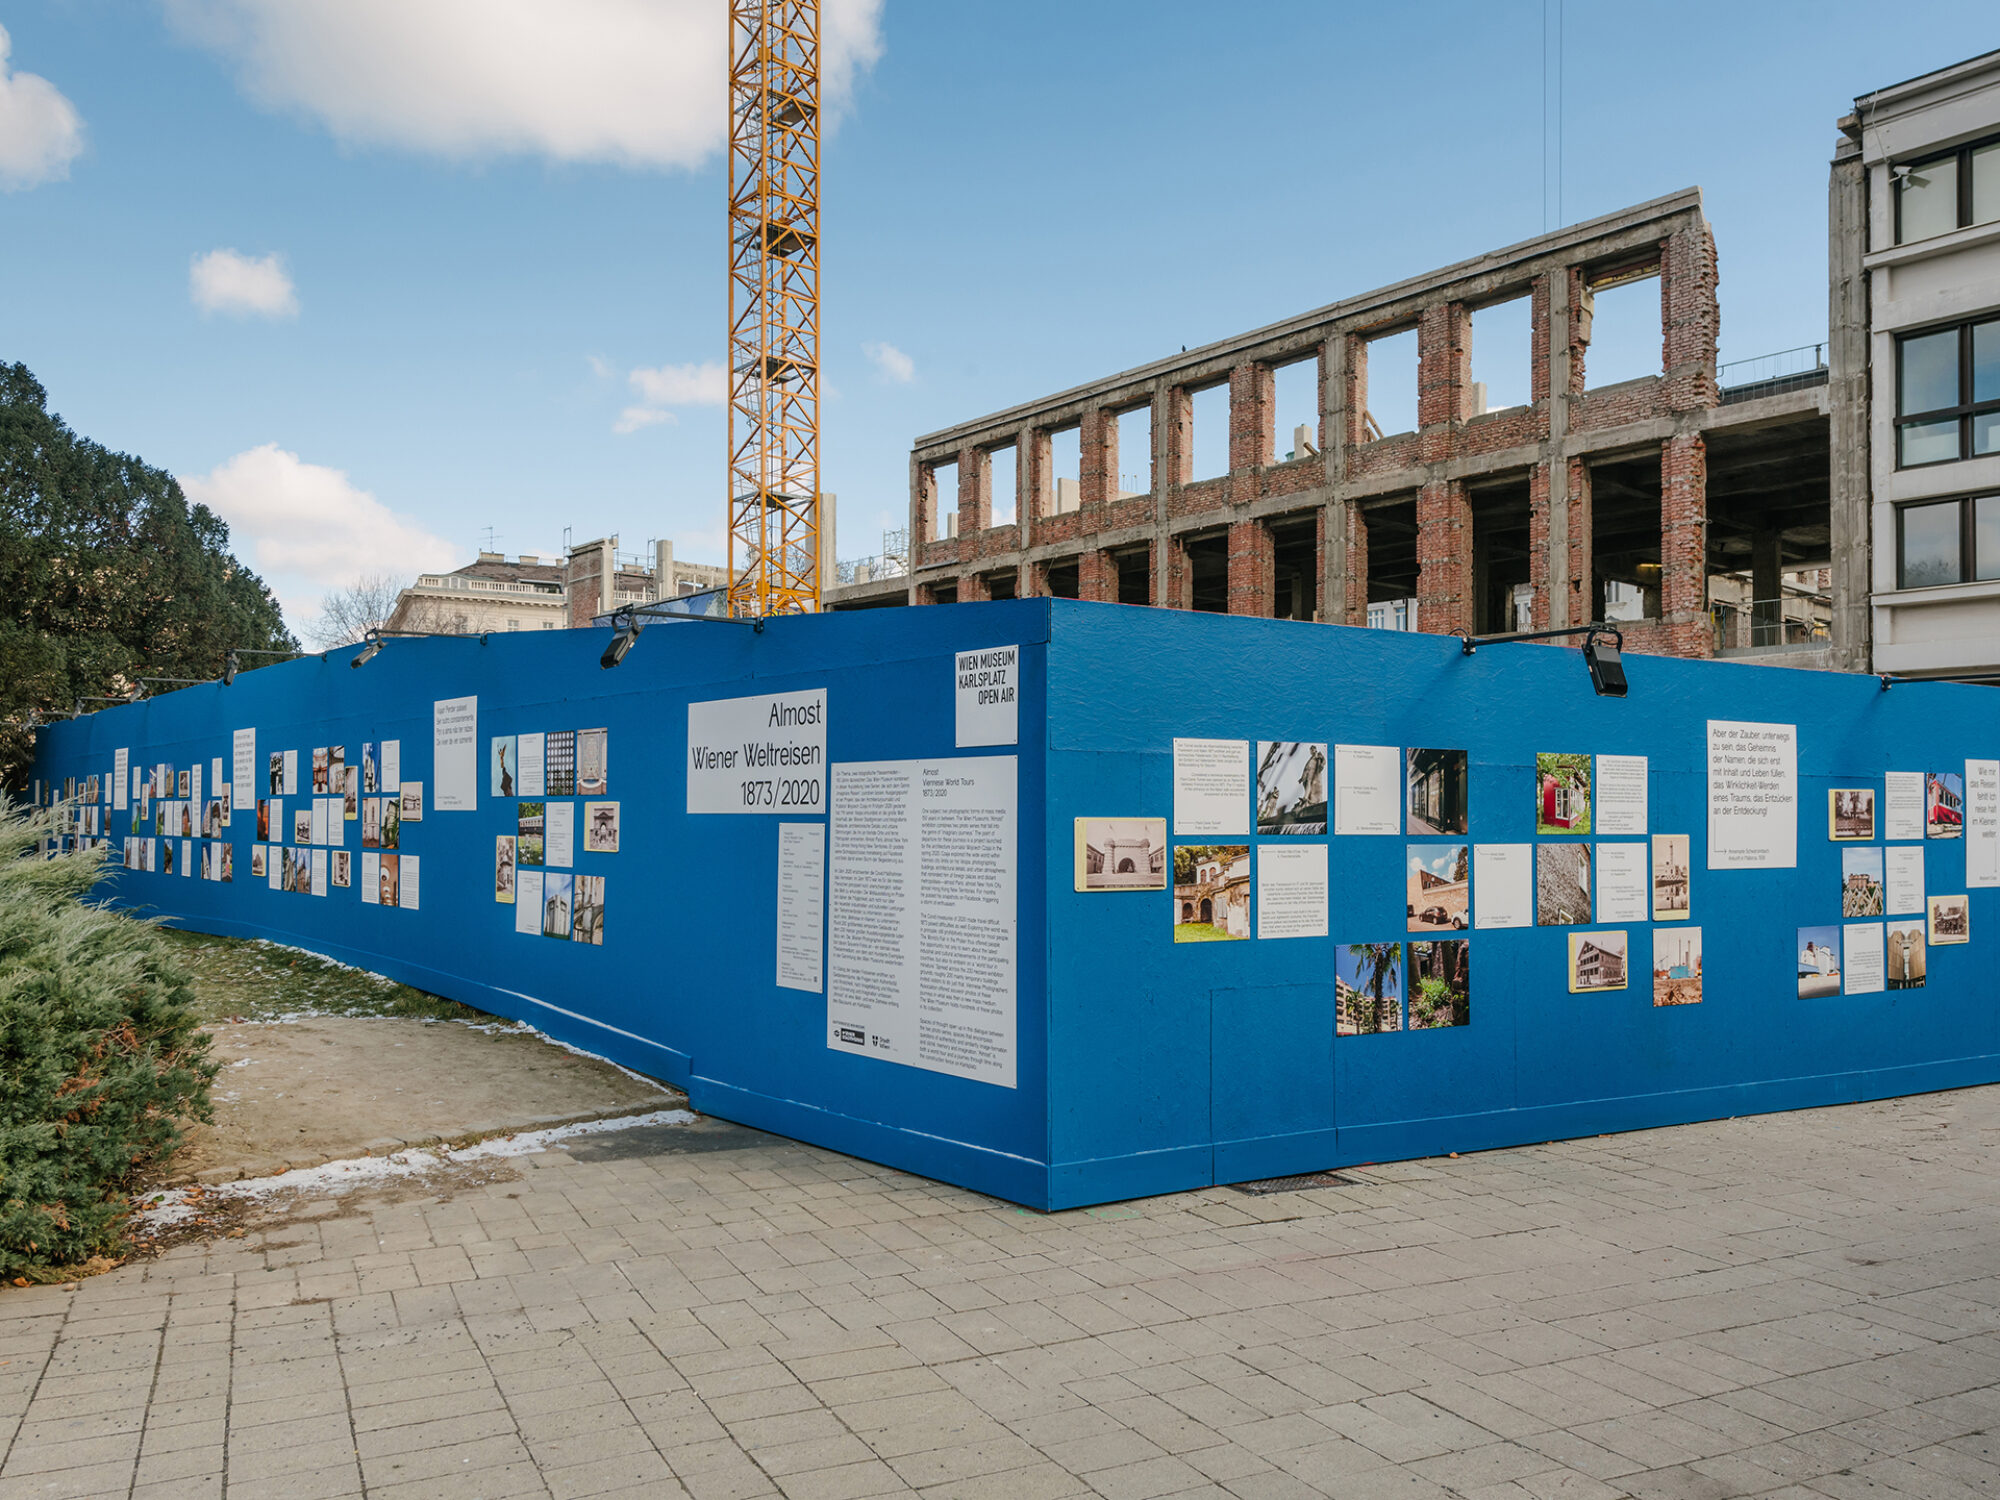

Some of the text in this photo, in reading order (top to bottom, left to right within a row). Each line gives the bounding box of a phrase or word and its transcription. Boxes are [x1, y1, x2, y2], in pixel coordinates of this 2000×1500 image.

[958, 650, 1015, 671] WIEN MUSEUM
[959, 670, 1006, 689] KARLSPLATZ
[978, 687, 1014, 704] OPEN AIR
[769, 699, 821, 728] Almost
[1712, 728, 1726, 738] Aber
[1728, 729, 1738, 738] der
[1736, 744, 1746, 752] das
[1748, 743, 1776, 752] Geheimnis
[692, 741, 820, 770] Wiener Weltreisen
[1712, 755, 1723, 764] der
[1748, 755, 1756, 765] die
[1752, 770, 1769, 778] Leben
[1713, 781, 1724, 789] das
[741, 777, 820, 808] 1873/2020
[1713, 794, 1728, 802] eines
[1753, 794, 1764, 803] das
[1722, 806, 1732, 815] der
